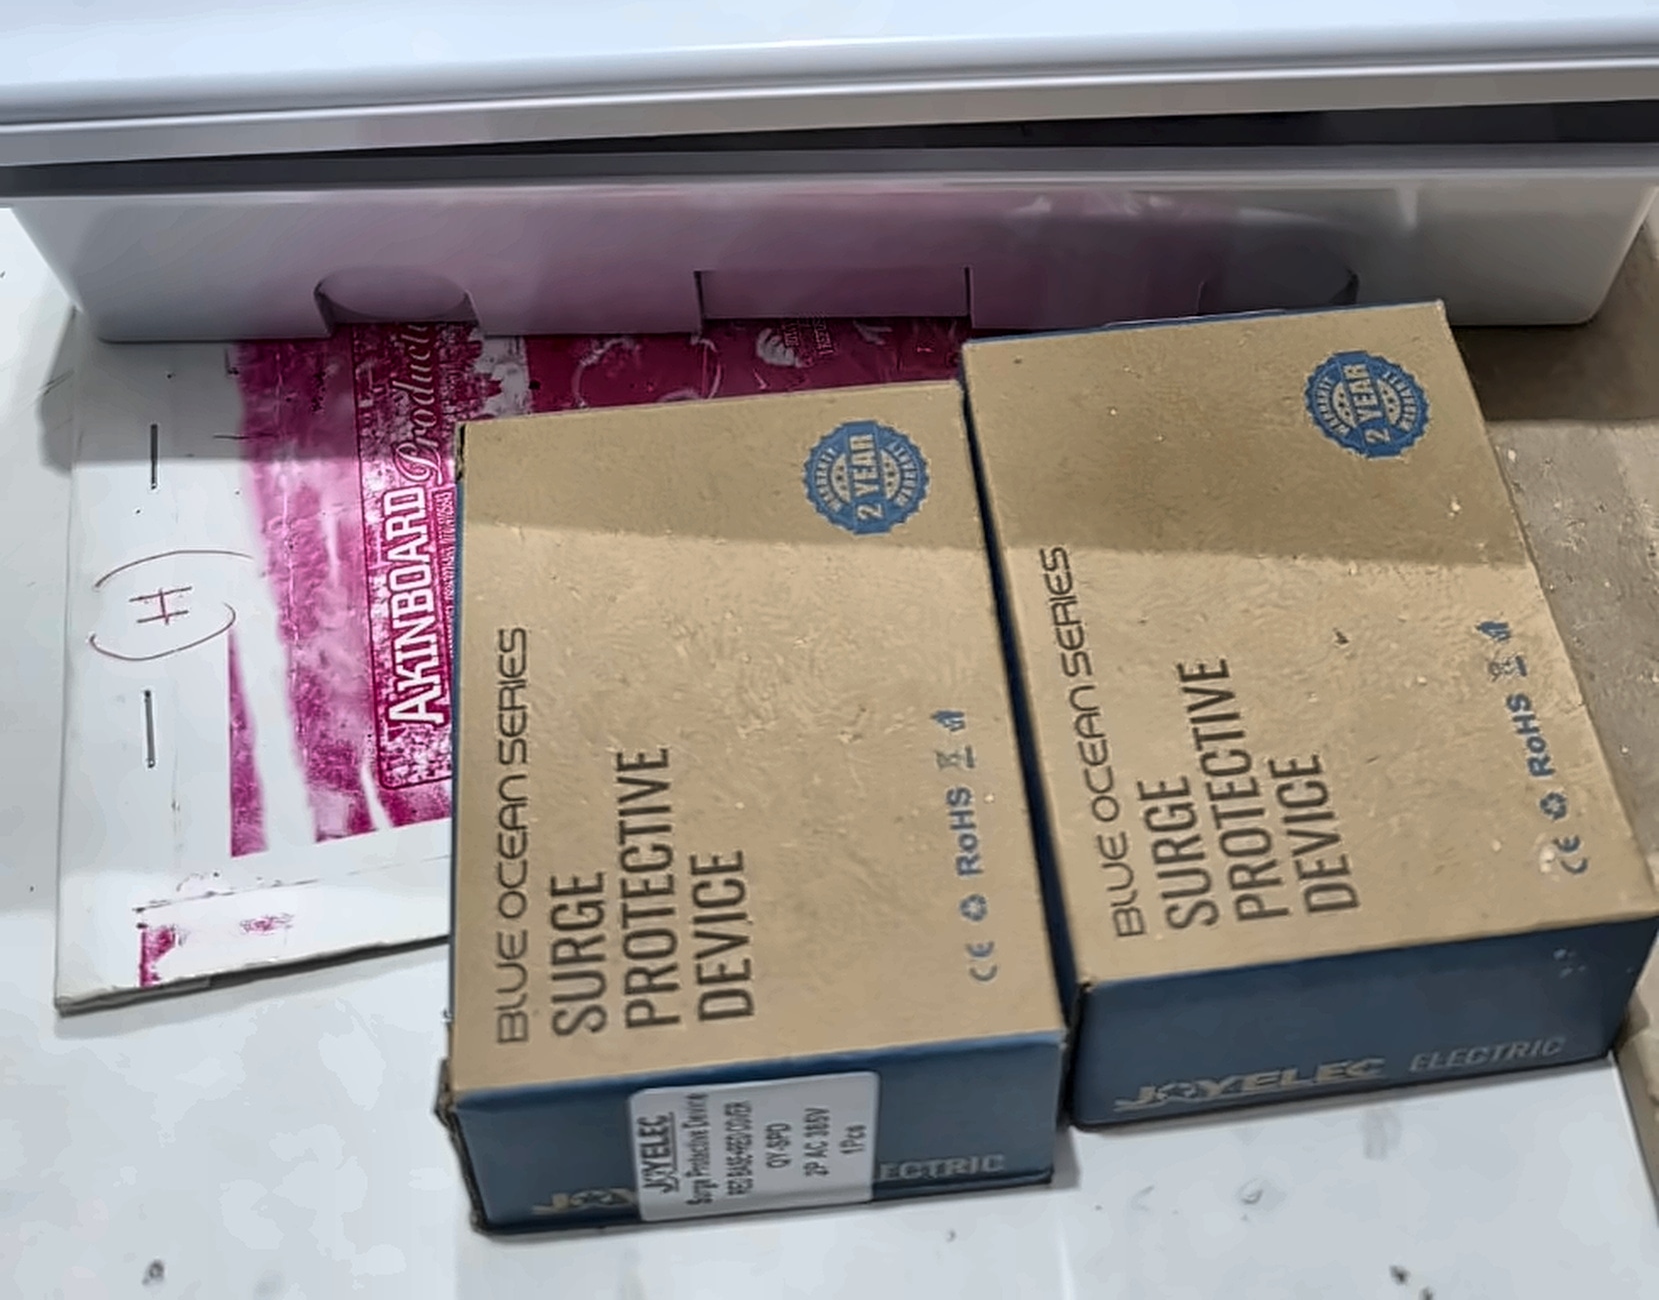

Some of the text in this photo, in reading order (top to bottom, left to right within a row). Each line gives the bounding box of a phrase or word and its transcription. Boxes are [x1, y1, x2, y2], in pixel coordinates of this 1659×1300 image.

[1343, 364, 1391, 443] 2 YEAR
[850, 433, 884, 521] 2 YEAR
[1039, 546, 1146, 938] BLUE OCEAN SERIES
[1506, 693, 1555, 777] RoHS
[946, 786, 983, 877] RoHS
[1177, 658, 1290, 922] PROTECTIVE
[1268, 754, 1360, 913] DEVICE
[497, 627, 528, 1044] BLUE OCEAN SERIES
[1137, 775, 1220, 930] SURGE
[615, 748, 681, 1029] PROTECTIVE
[550, 872, 607, 1036] SURGE
[689, 850, 755, 1021] DEVICE
[1114, 1036, 1567, 1112] JOYELEC ELECTRIC
[638, 1113, 676, 1194] JOYELEC
[766, 1123, 792, 1169] QY-SPD
[804, 1141, 828, 1159] AC
[840, 1125, 866, 1155] 1Pcs
[879, 1154, 1005, 1181] ECTRIC
